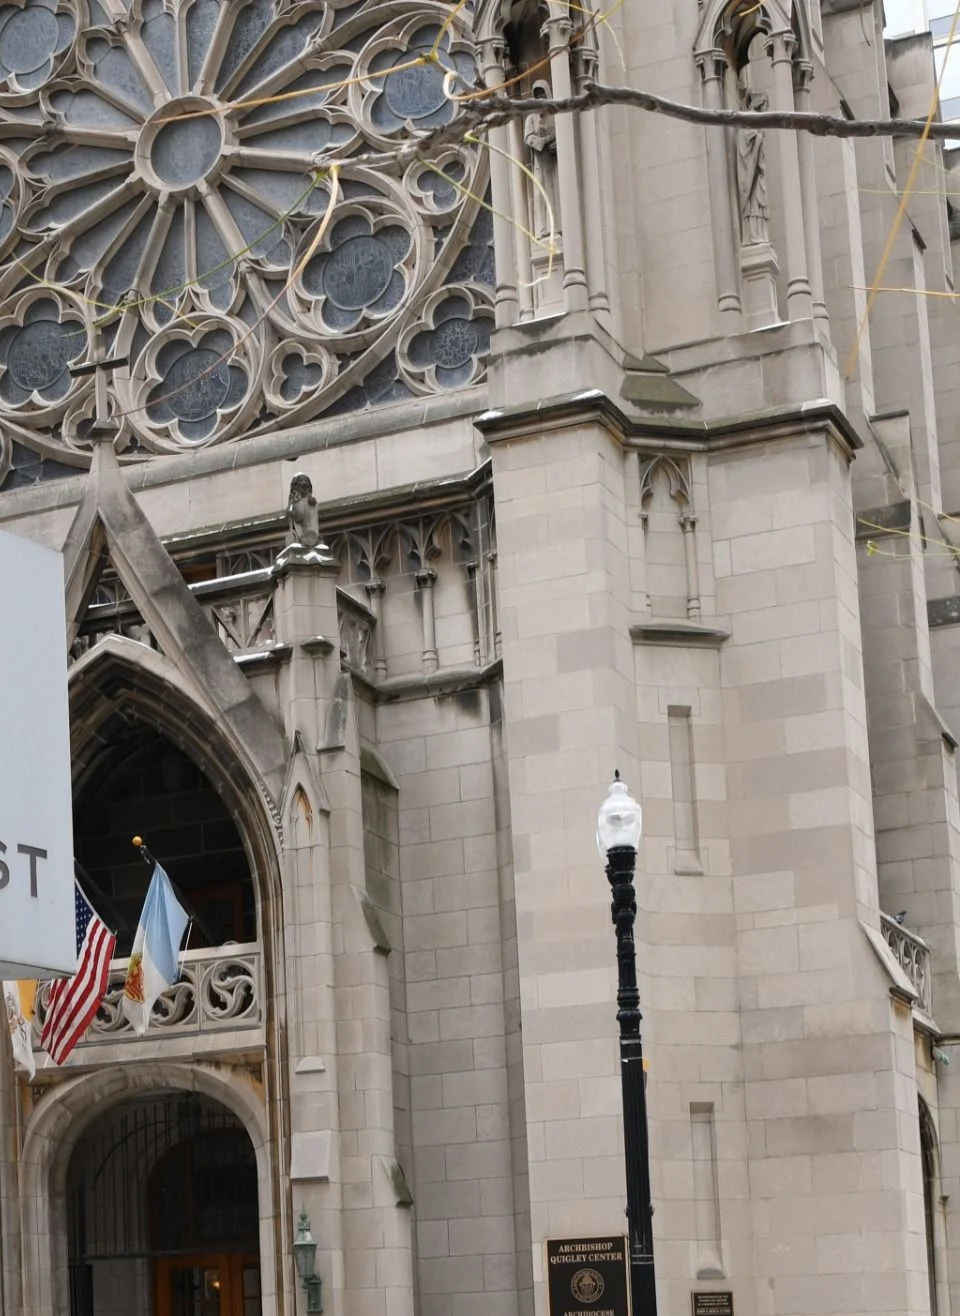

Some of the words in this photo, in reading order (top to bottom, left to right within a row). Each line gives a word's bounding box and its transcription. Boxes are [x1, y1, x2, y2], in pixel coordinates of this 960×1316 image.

[558, 1242, 613, 1253] ARCHBISHOP
[550, 1254, 587, 1264] QUIGLEY
[588, 1252, 623, 1262] CENTER
